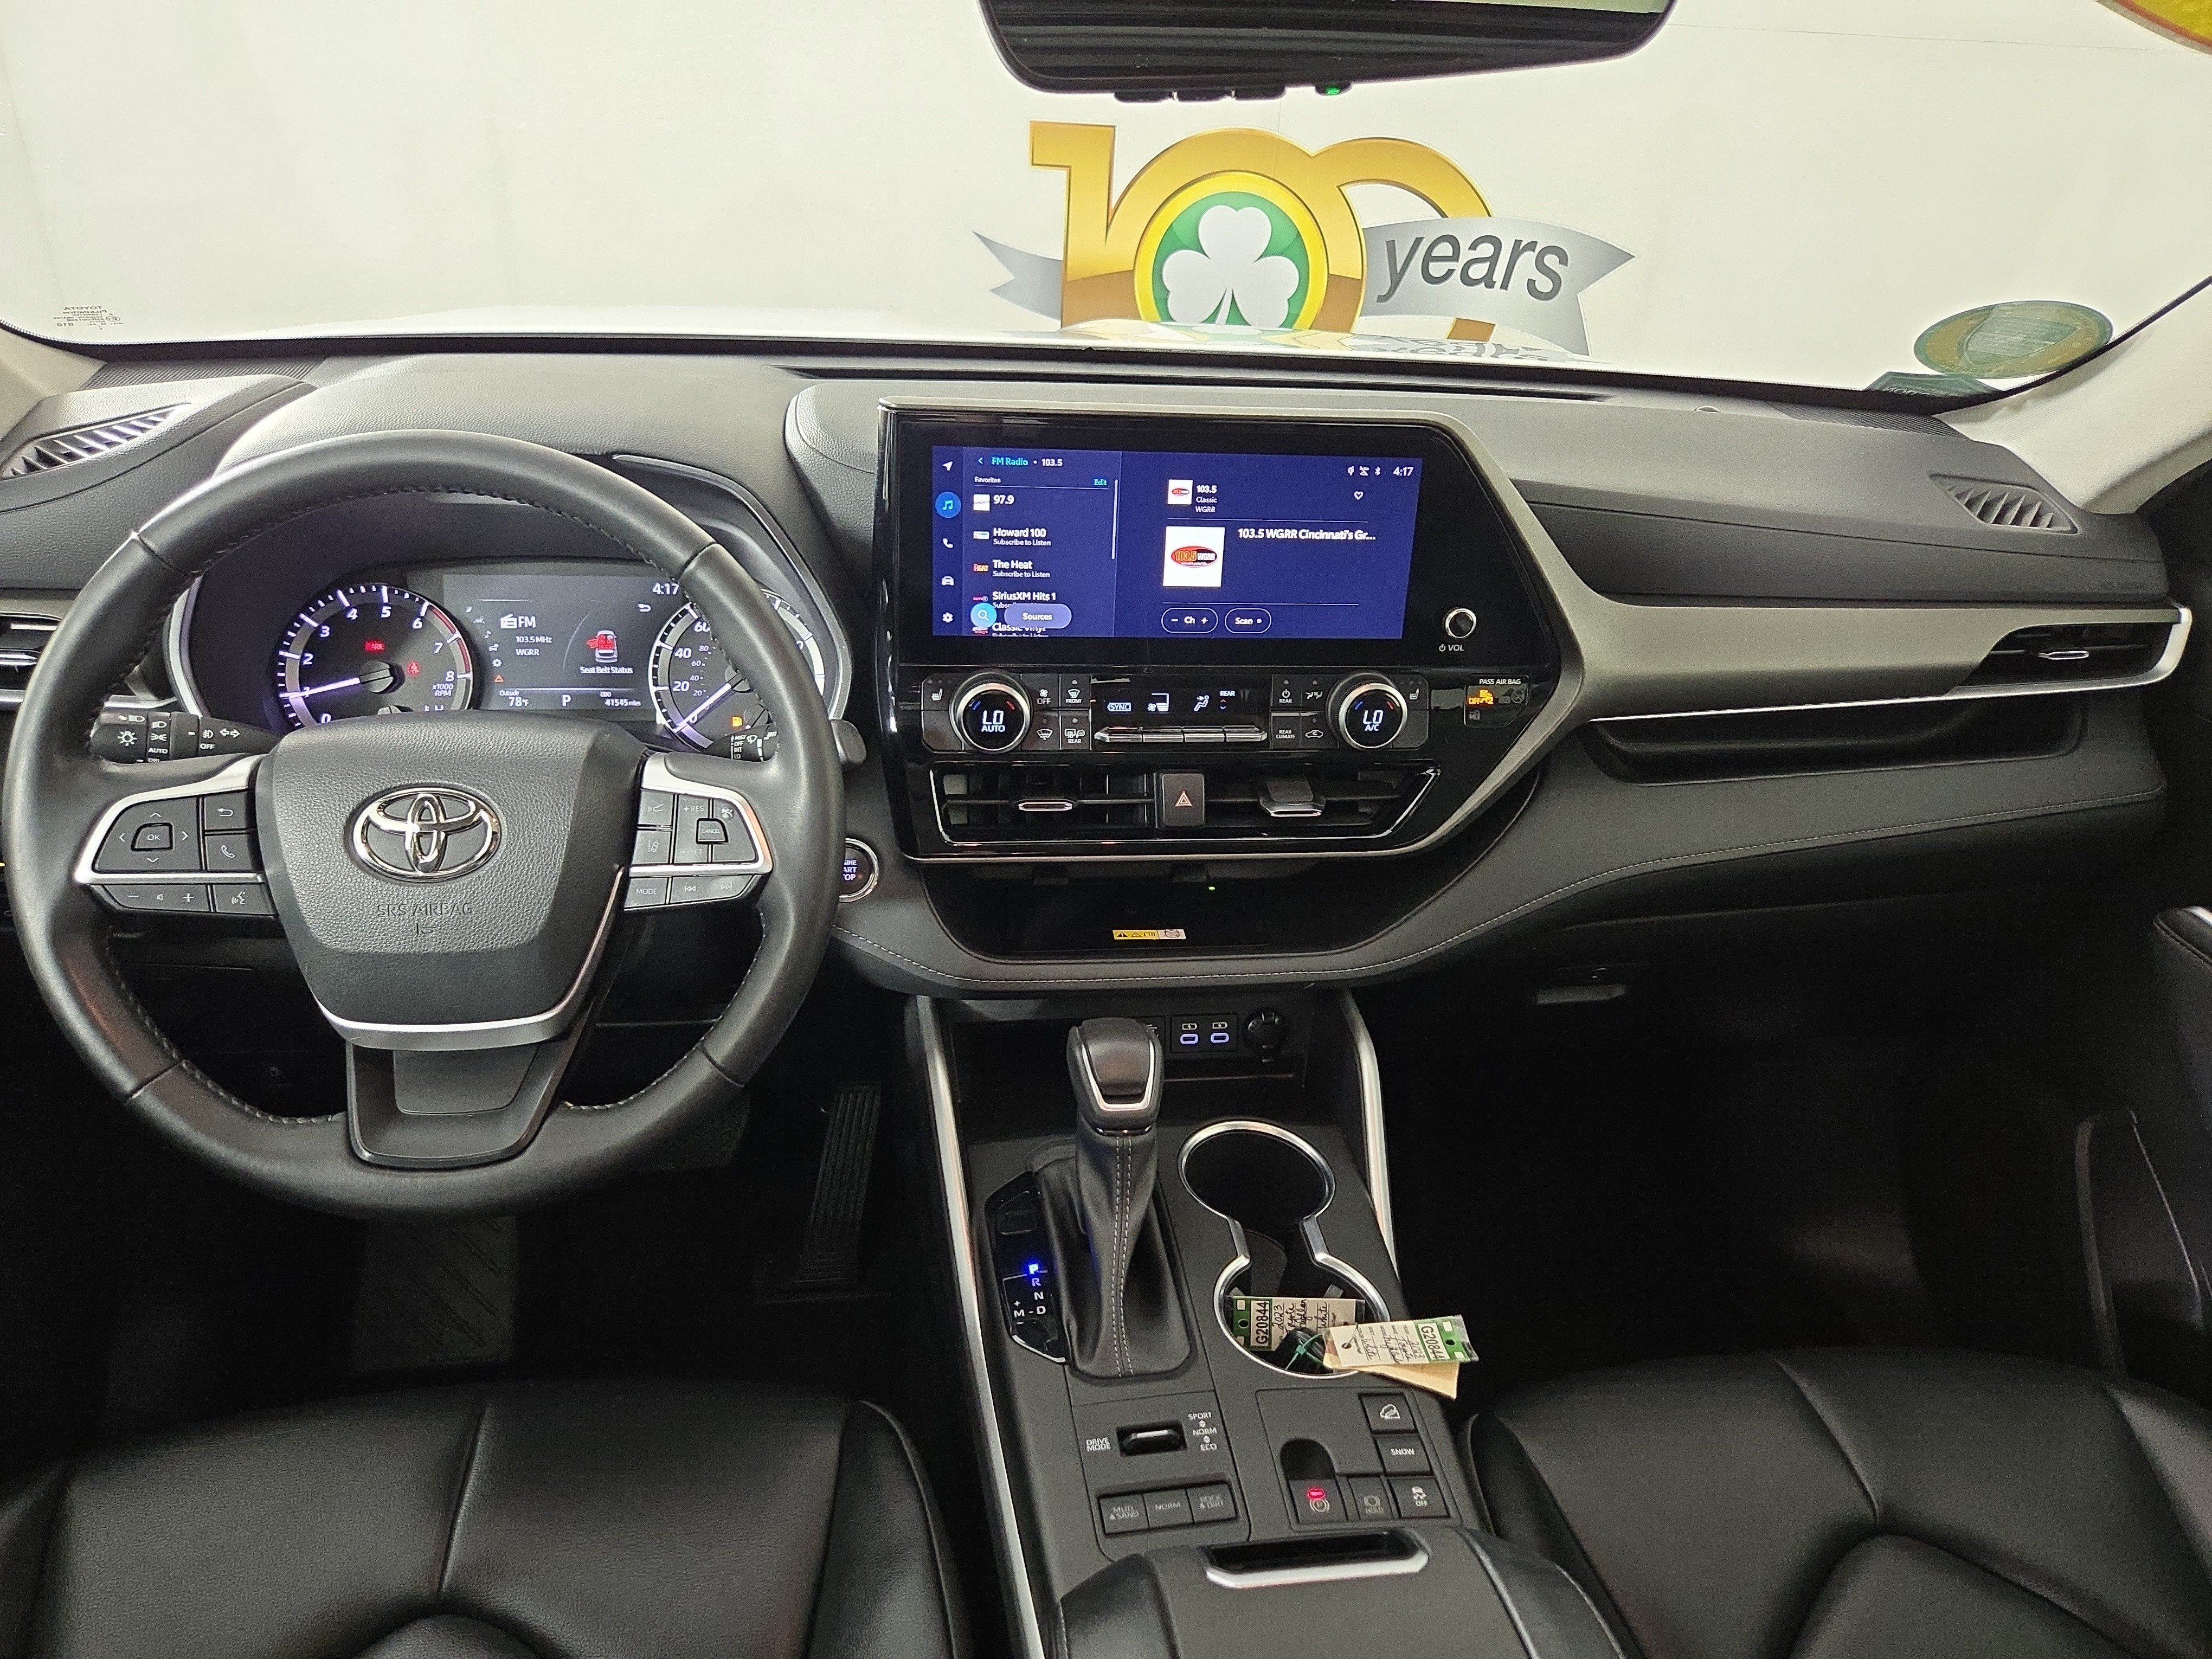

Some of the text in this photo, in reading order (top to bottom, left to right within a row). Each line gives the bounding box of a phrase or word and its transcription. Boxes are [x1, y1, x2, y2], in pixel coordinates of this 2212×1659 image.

[1377, 234, 1568, 303] years
[992, 457, 1063, 467] FM Radio 103.5
[1393, 466, 1414, 477] 4:17
[1197, 485, 1217, 493] 103.5
[993, 494, 1014, 505] 97.9
[993, 528, 1046, 538] Howard 100
[1238, 528, 1264, 538] 103.5
[1265, 529, 1297, 539] WGRR
[1298, 529, 1354, 539] Cincinnati's
[1175, 551, 1197, 561] 103.5
[993, 559, 1033, 569] The Heat
[652, 583, 679, 595] 4:17
[992, 591, 1031, 601] SiriusXM
[1032, 591, 1050, 601] Hits
[1051, 592, 1056, 601] 1
[346, 608, 358, 620] 4
[381, 606, 391, 618] 5
[1023, 612, 1053, 620] Sources
[413, 618, 423, 629] 6
[518, 616, 536, 628] FM
[1184, 616, 1195, 625] Ch
[1235, 616, 1253, 625] Scan
[320, 626, 330, 637] 3
[516, 635, 552, 644] 103.5 MHz
[434, 642, 443, 654] 7
[516, 648, 540, 656] WGRR
[674, 647, 692, 659] 40
[303, 653, 314, 665] 2
[611, 666, 633, 674] Status
[445, 671, 455, 682] 8
[672, 680, 690, 692] 20
[562, 695, 571, 706] P
[982, 710, 1004, 725] LO
[1362, 710, 1384, 725] LO
[377, 902, 473, 917] SRS AIRBAG
[1029, 1263, 1038, 1275] P
[1032, 1277, 1041, 1287] R
[1034, 1291, 1044, 1300] N
[1013, 1306, 1046, 1318] M D
[1272, 1304, 1283, 1330] 2023
[1314, 1301, 1327, 1329] White
[1255, 1301, 1269, 1344] G20844
[1188, 1411, 1212, 1420] SPORT
[1192, 1427, 1217, 1436] NORM
[1086, 1437, 1109, 1446] DRIVE
[1200, 1443, 1217, 1451] ECO
[1086, 1443, 1111, 1452] MODE
[1113, 1505, 1133, 1514] MUD
[1155, 1502, 1181, 1511] NORM
